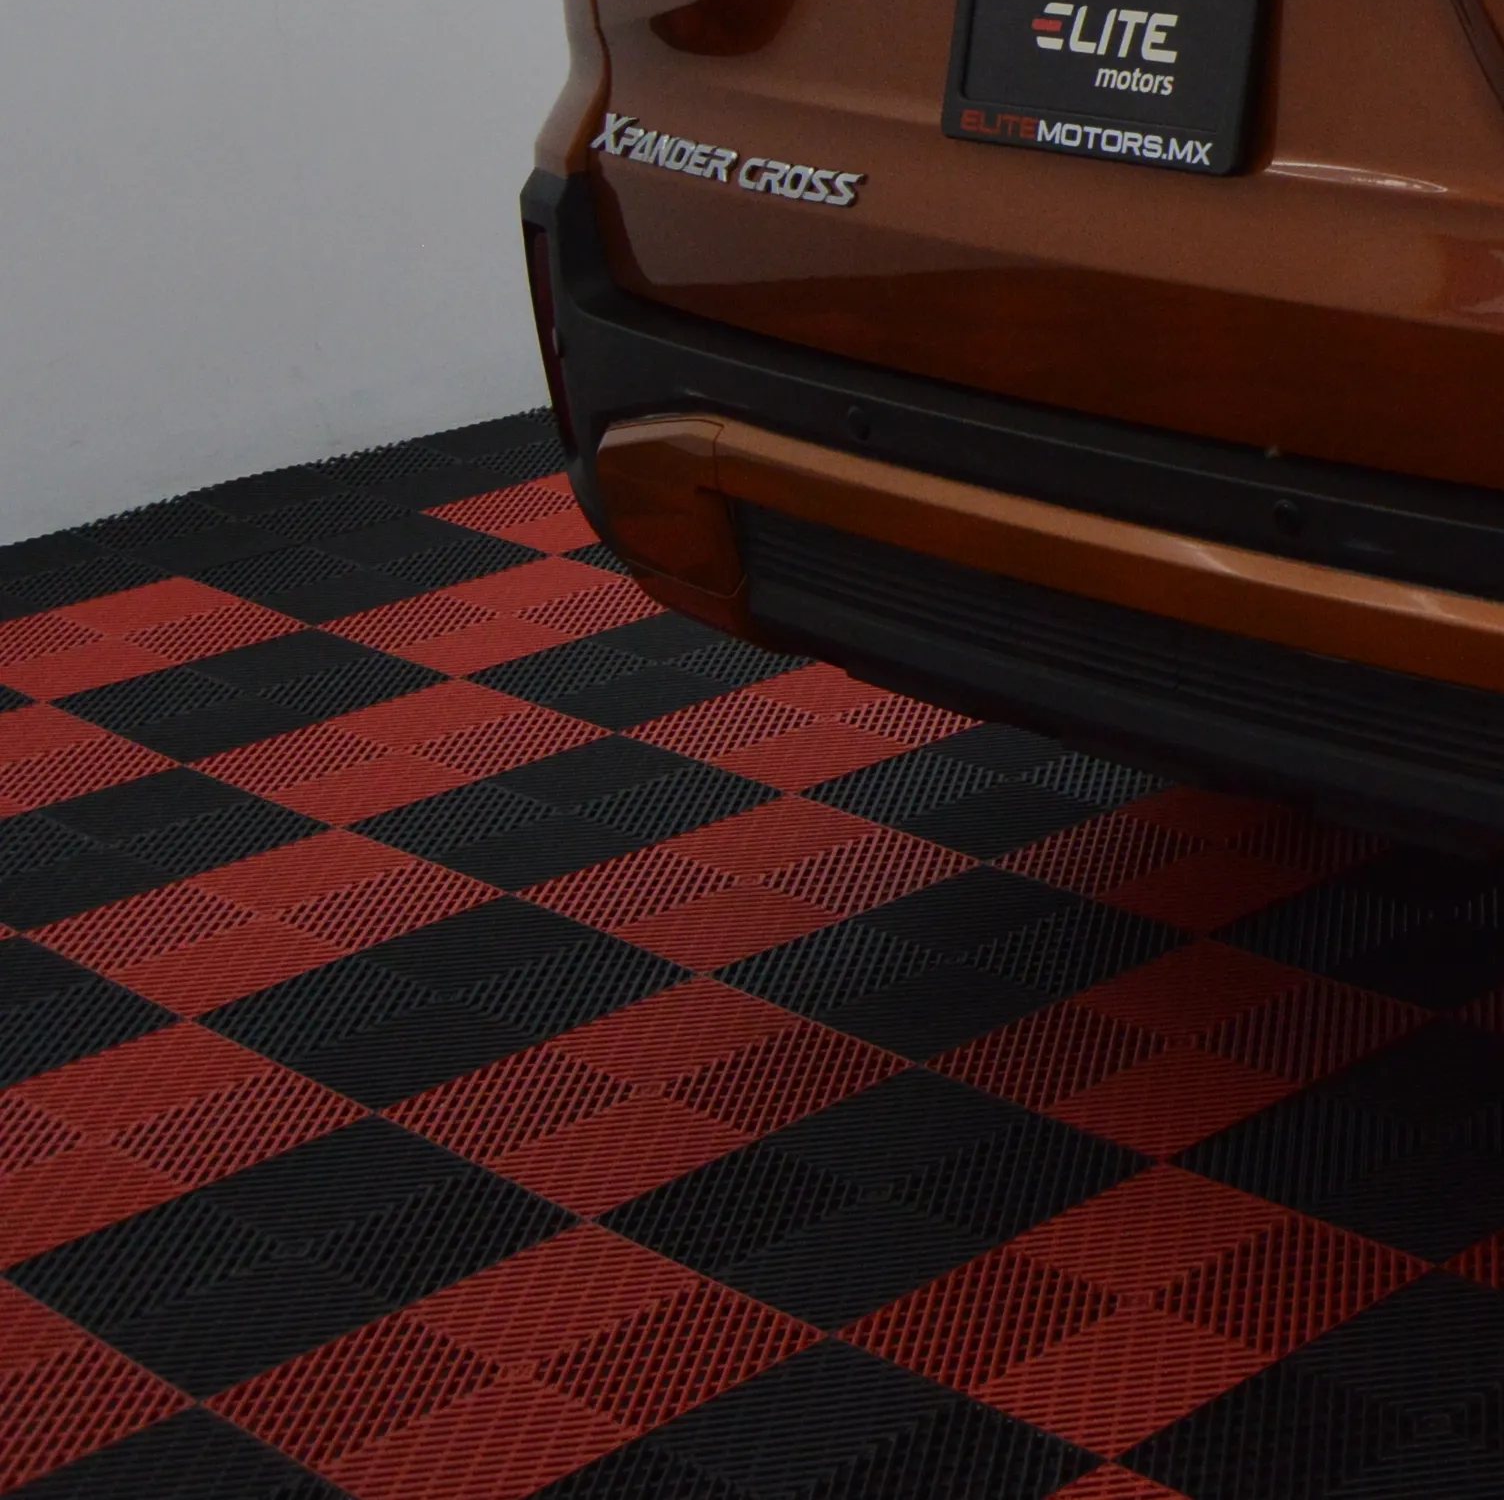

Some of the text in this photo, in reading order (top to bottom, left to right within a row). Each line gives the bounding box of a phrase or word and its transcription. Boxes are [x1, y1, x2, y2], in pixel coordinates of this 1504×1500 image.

[1031, 2, 1179, 64] ELITE
[1094, 66, 1175, 96] motors
[590, 112, 867, 206] XPANDER CROSS
